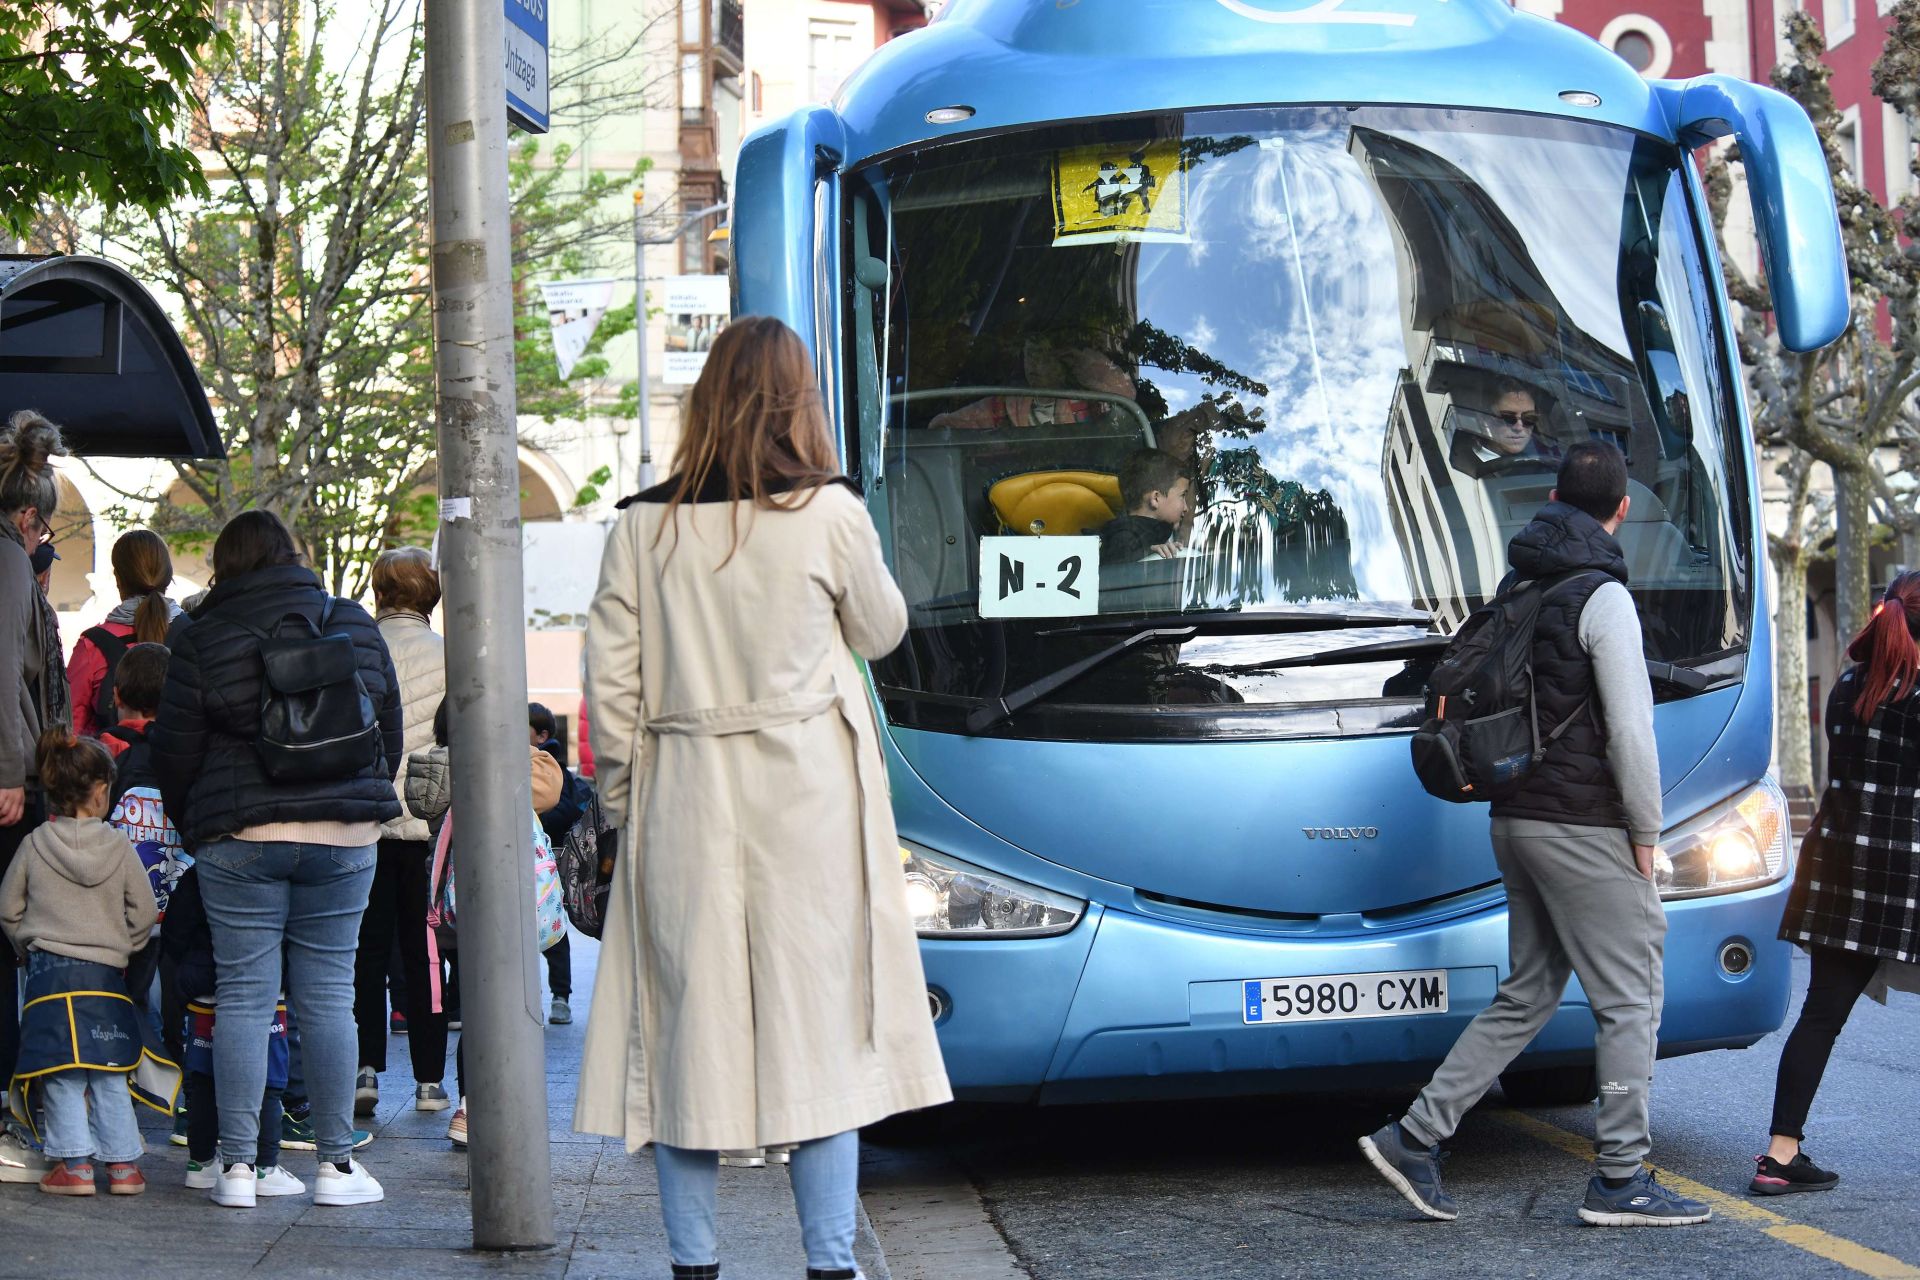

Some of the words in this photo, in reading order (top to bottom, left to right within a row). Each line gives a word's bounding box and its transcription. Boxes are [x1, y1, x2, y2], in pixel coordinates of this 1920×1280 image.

[504, 37, 536, 92] Untzaga
[1302, 826, 1378, 840] VOLVO
[1273, 982, 1358, 1017] 5980
[1377, 976, 1440, 1011] CXM
[1250, 1006, 1258, 1016] E
